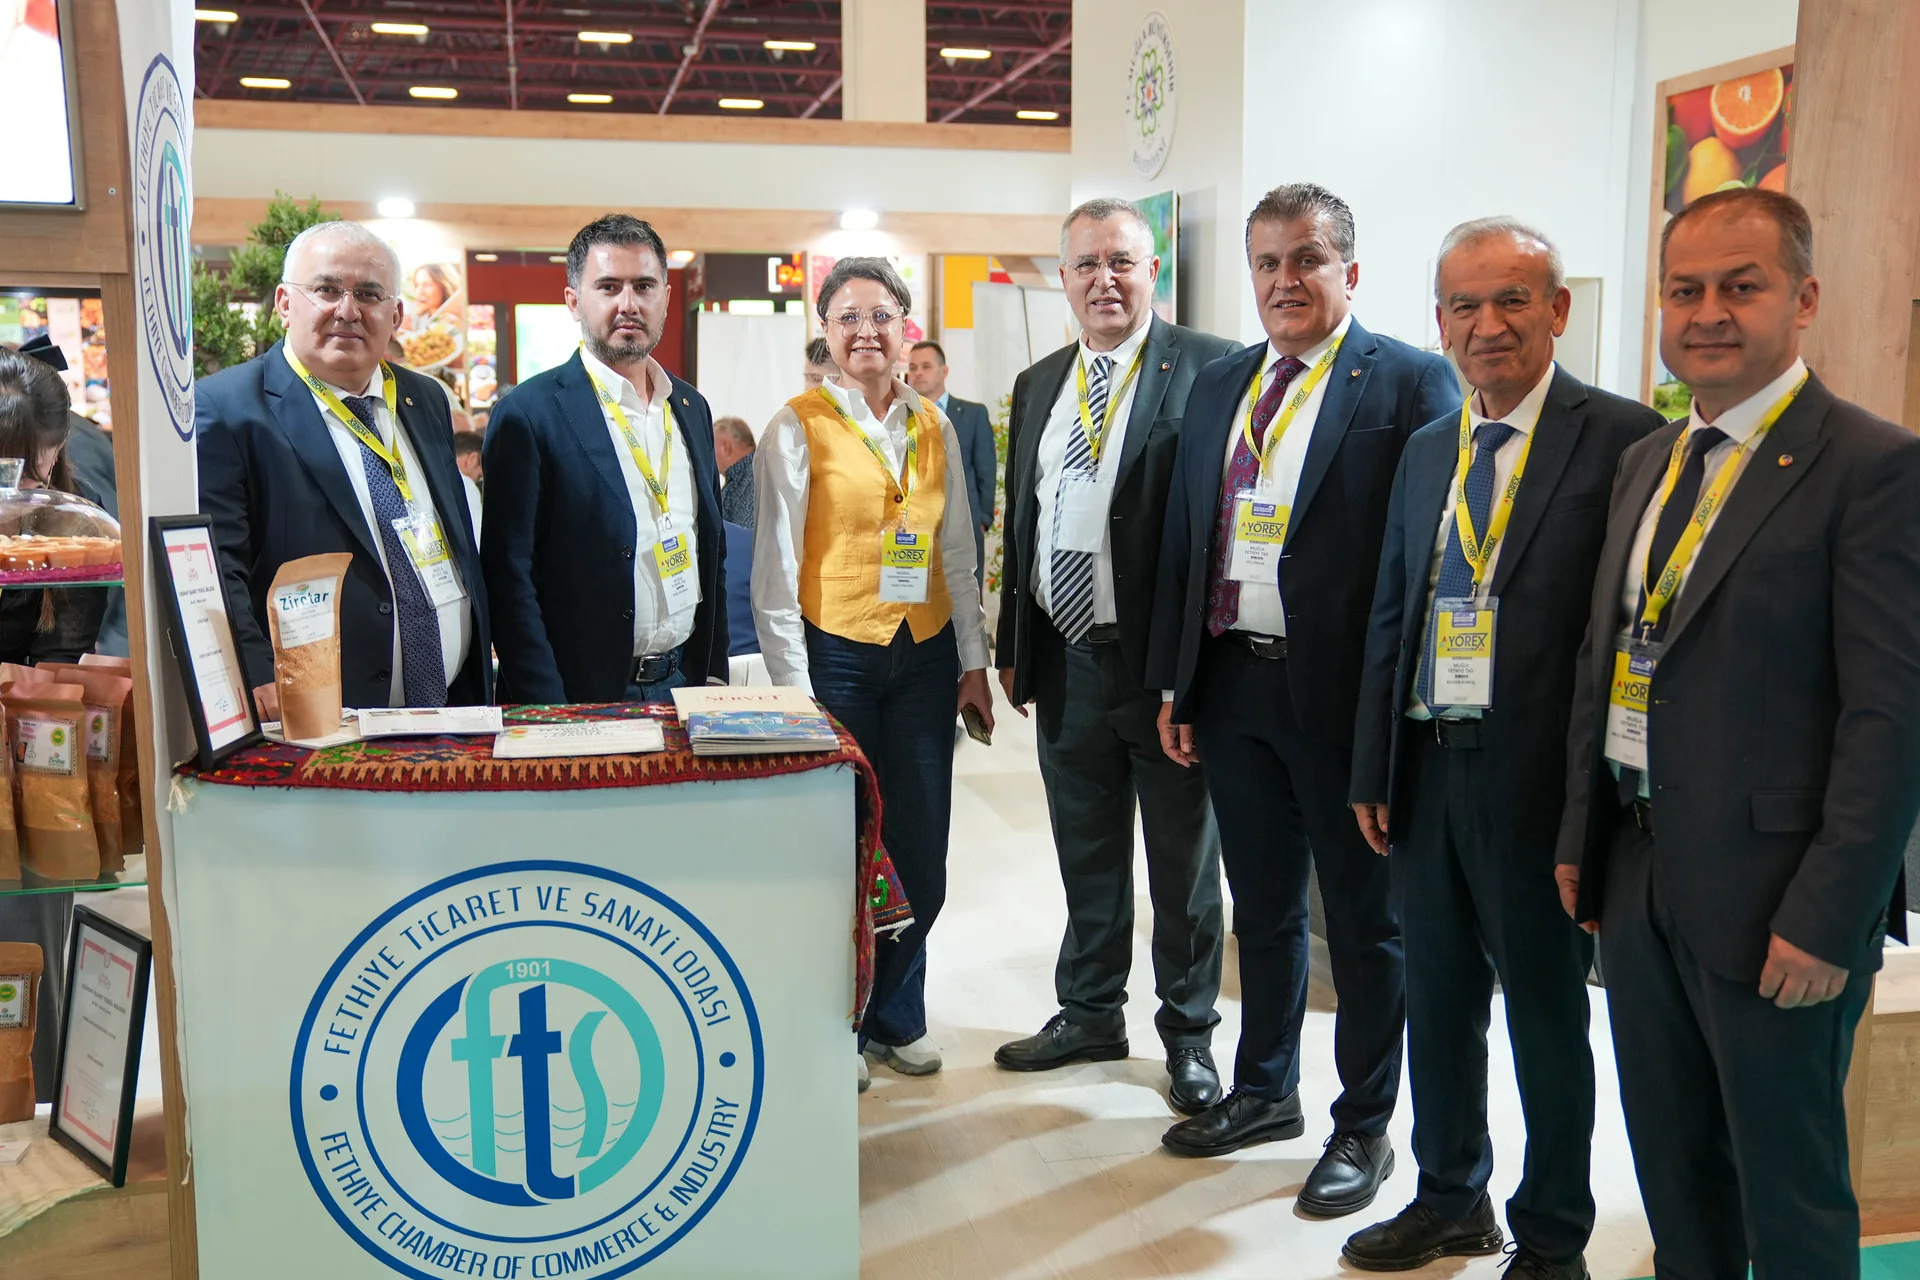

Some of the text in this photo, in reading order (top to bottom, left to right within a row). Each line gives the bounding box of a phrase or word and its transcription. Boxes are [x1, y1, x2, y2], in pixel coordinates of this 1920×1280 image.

[1623, 681, 1650, 700] YOR
[505, 960, 552, 980] 1901
[536, 885, 571, 912] VE
[672, 949, 732, 1028] ODASI
[320, 1096, 740, 1280] FETHIYE CHAMBER OF COMMERCE & INDUSTRY
